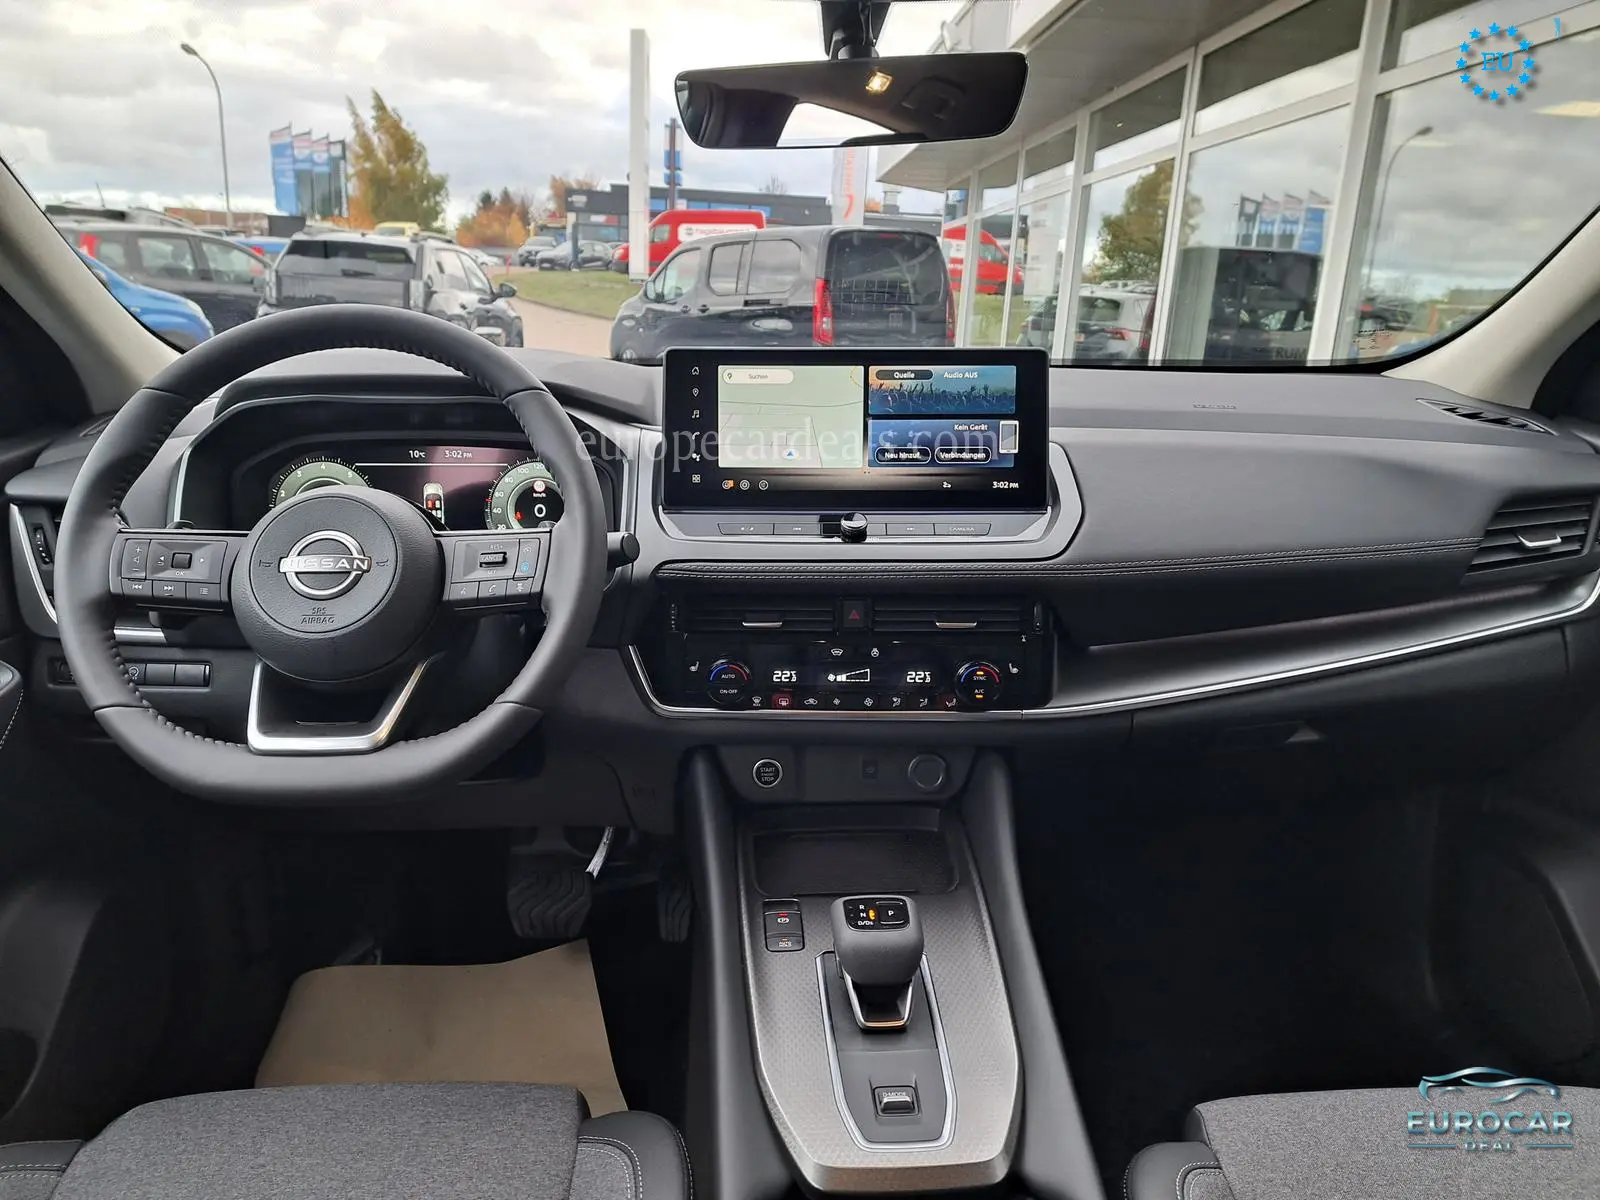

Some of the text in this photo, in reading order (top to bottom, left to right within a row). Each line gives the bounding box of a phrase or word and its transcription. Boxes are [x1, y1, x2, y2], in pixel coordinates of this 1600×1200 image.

[893, 371, 915, 380] Quelle
[943, 371, 978, 379] Audio AUS
[954, 422, 988, 431] Kein Gerät
[444, 450, 462, 459] 3:02
[885, 451, 922, 460] Neu hinzuf.
[940, 451, 986, 461] Verbindungen
[296, 470, 302, 478] 3
[992, 480, 1009, 489] 3:02
[534, 503, 546, 518] 0
[281, 557, 368, 571] NISSAN
[312, 606, 327, 615] SRS
[300, 616, 336, 624] AIRBAG
